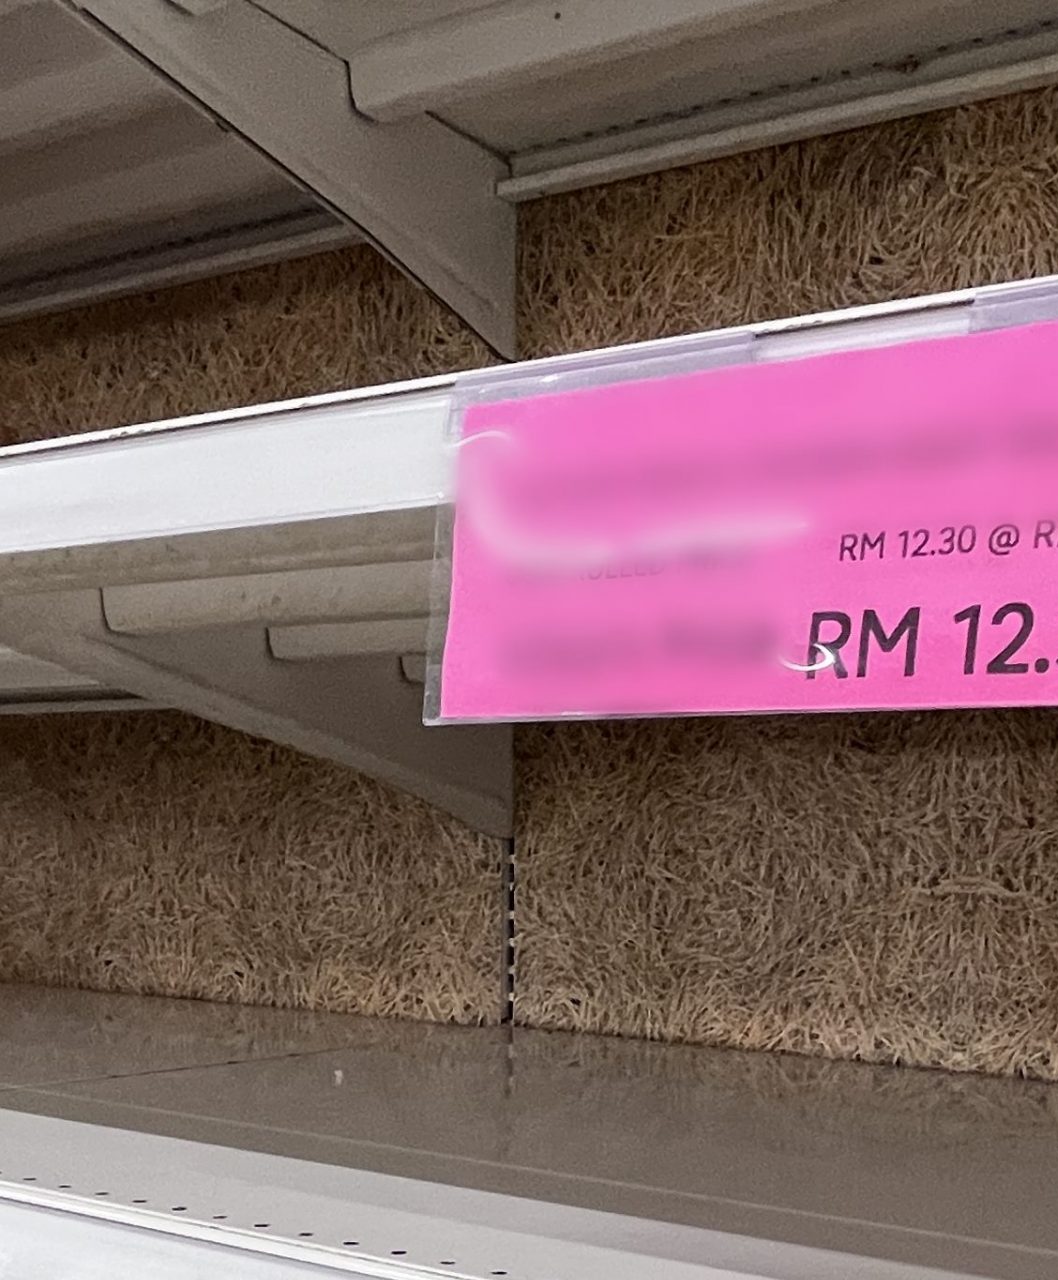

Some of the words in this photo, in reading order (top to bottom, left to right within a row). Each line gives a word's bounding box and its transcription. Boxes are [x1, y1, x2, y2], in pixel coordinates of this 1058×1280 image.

[839, 531, 886, 561] RM
[898, 524, 977, 559] 12.30
[987, 523, 1021, 556] @
[806, 606, 921, 680] RM
